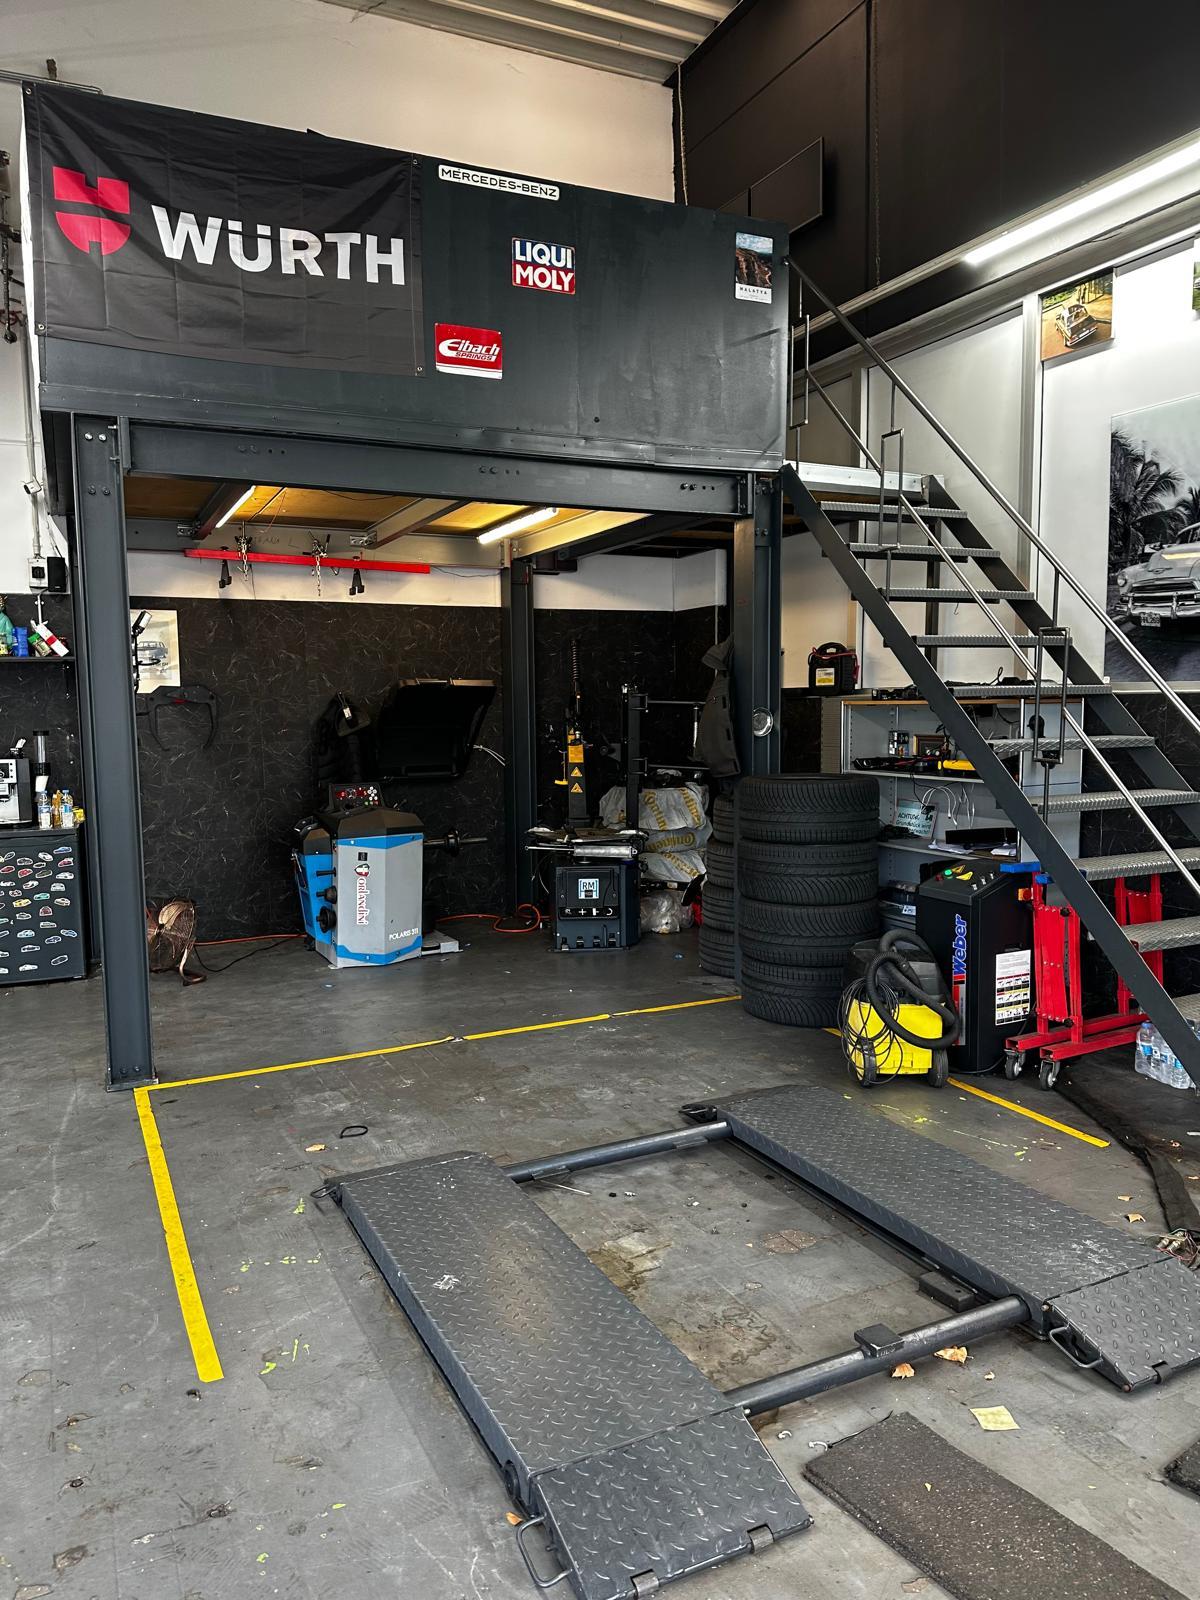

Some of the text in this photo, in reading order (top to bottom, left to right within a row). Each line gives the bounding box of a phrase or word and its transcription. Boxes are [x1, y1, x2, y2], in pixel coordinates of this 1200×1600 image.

[440, 167, 558, 198] MERCEDES-BENZ
[151, 204, 405, 286] WÜRTH
[515, 240, 573, 269] LIQUI
[515, 263, 575, 292] MOLY
[438, 338, 500, 357] Eibach
[455, 351, 493, 361] SPRINGS
[582, 881, 595, 890] RM
[388, 928, 412, 941] POLARIS
[952, 913, 967, 976] Weber
